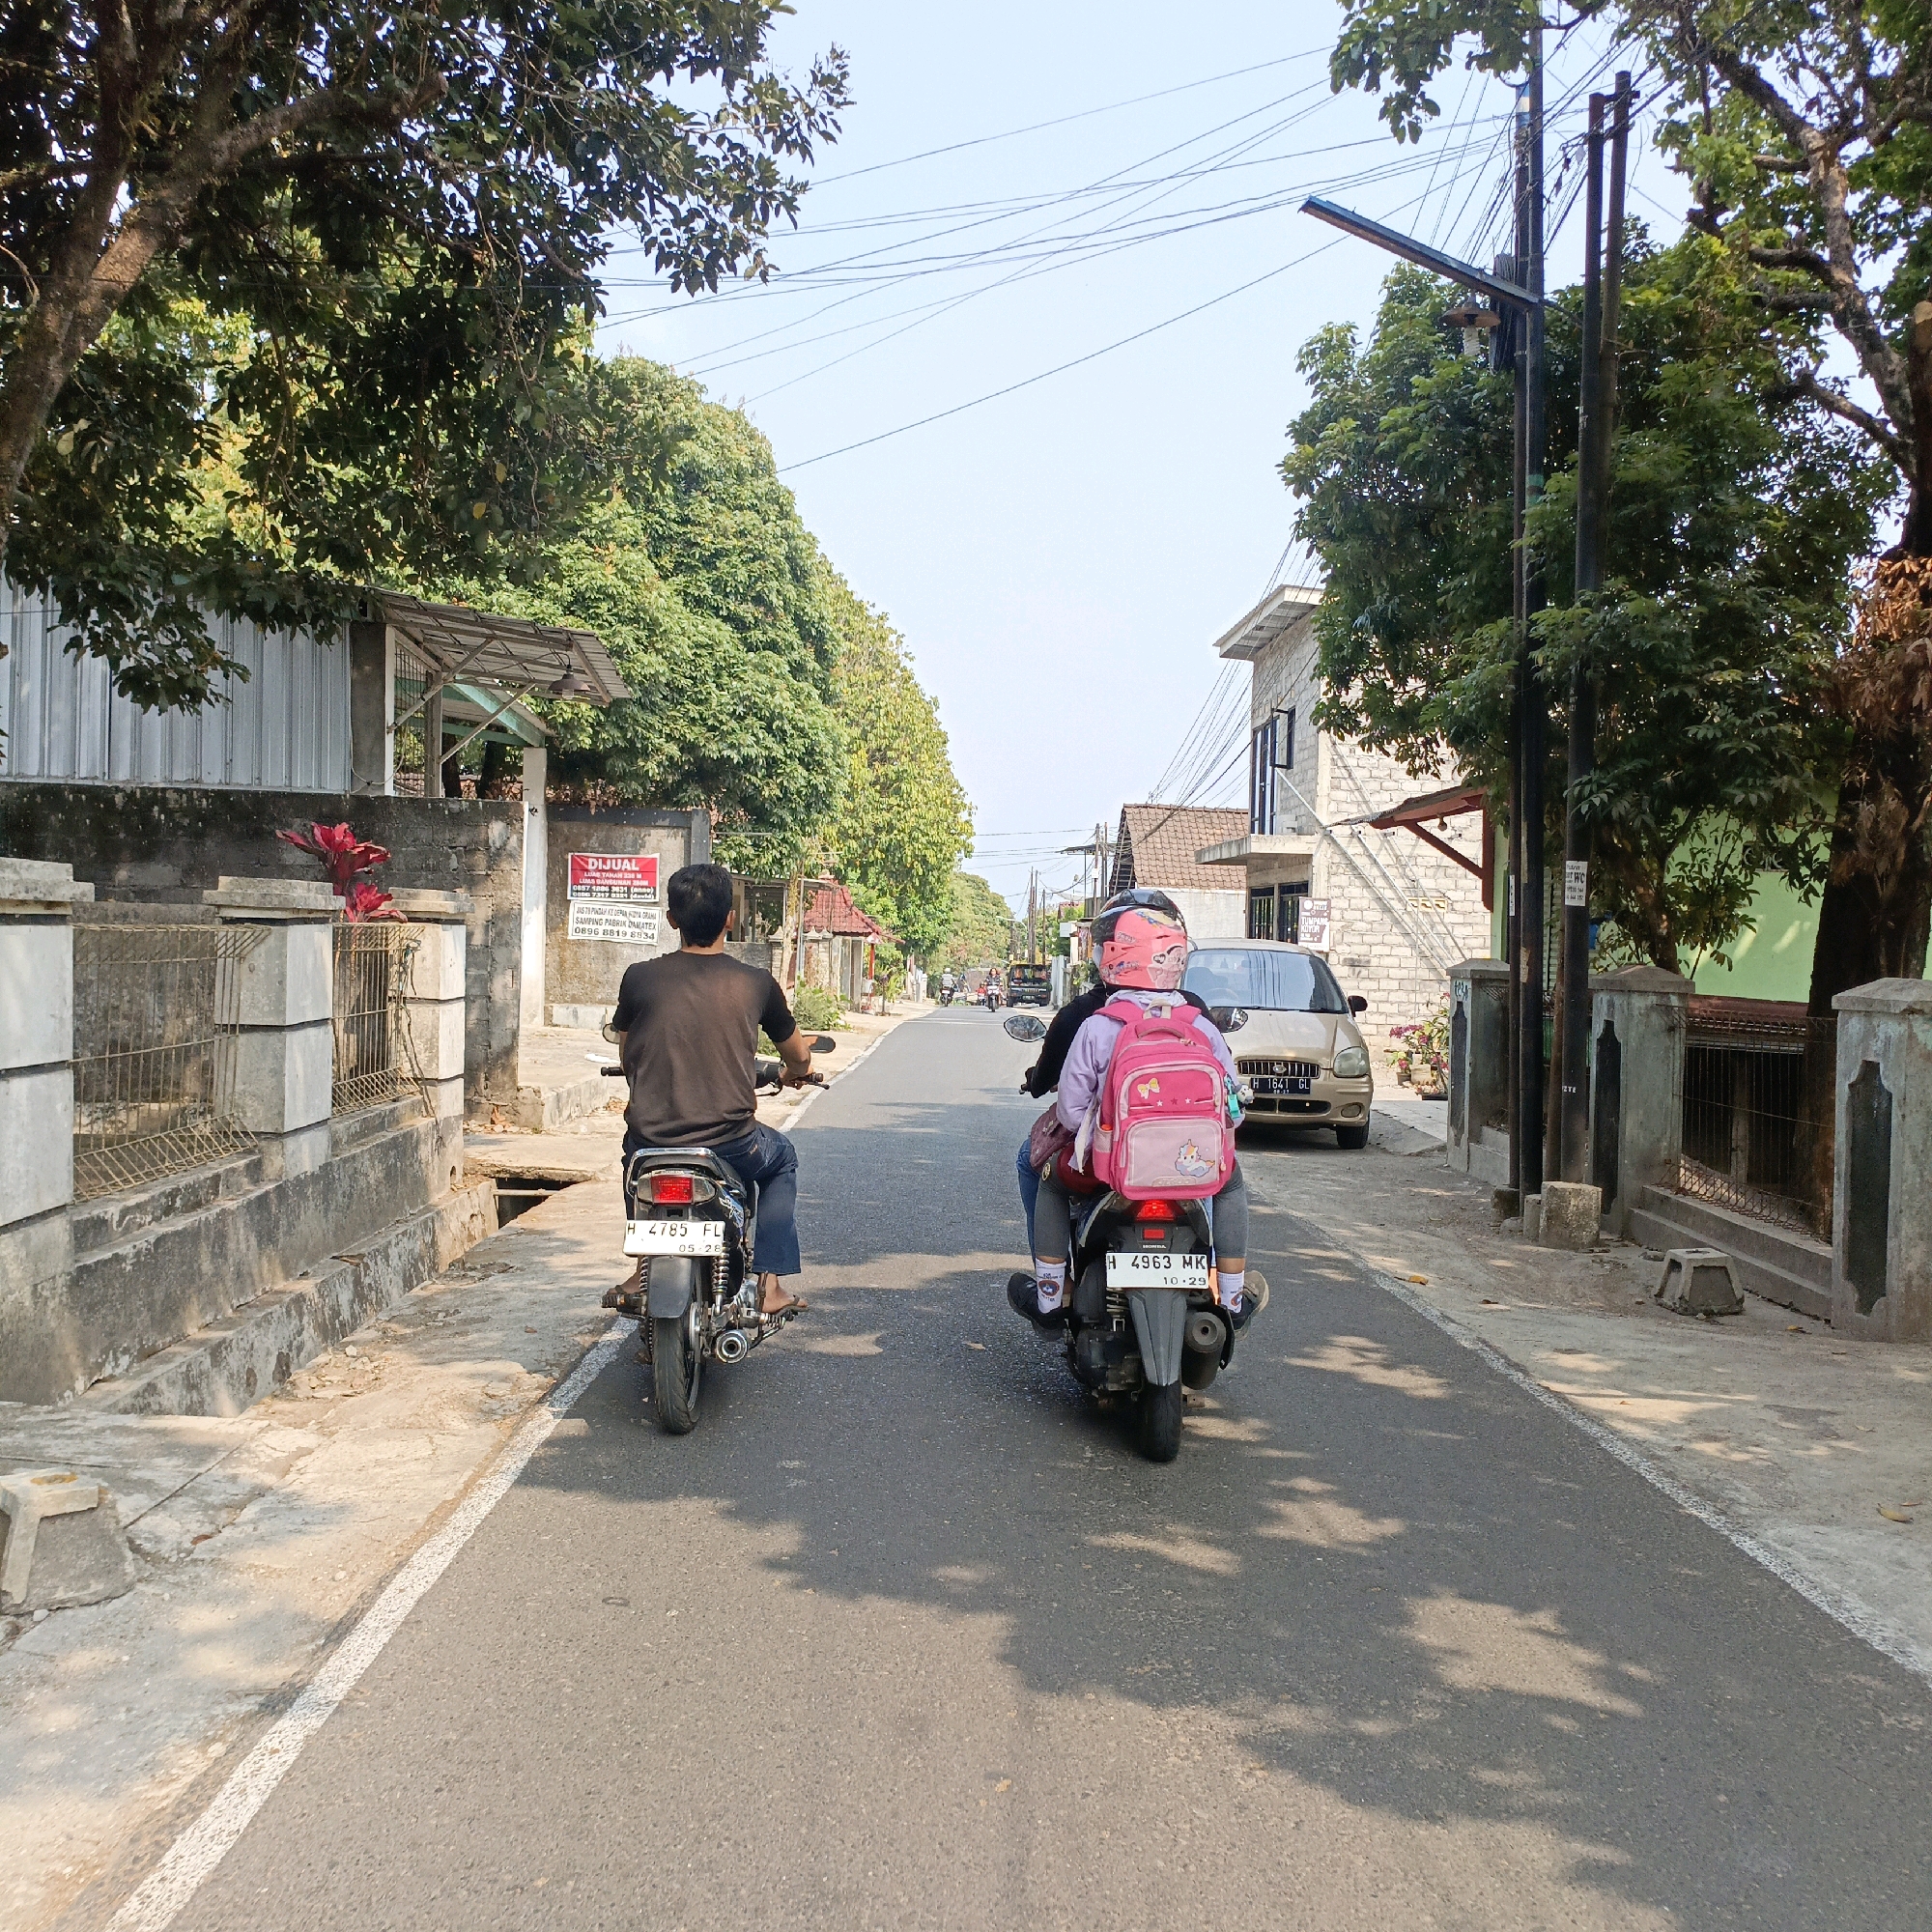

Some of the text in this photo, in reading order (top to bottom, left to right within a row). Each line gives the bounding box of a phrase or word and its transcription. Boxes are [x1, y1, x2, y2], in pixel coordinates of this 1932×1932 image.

[587, 858, 639, 871] DIJUAL
[576, 917, 604, 925] SAMPING
[605, 918, 627, 927] PABRIK
[575, 926, 599, 935] 0896
[603, 928, 627, 937] 8819
[1253, 1078, 1309, 1089] H 1641 GL
[627, 1223, 721, 1236] H 4785 FL
[1108, 1256, 1206, 1270] H 4963 MK
